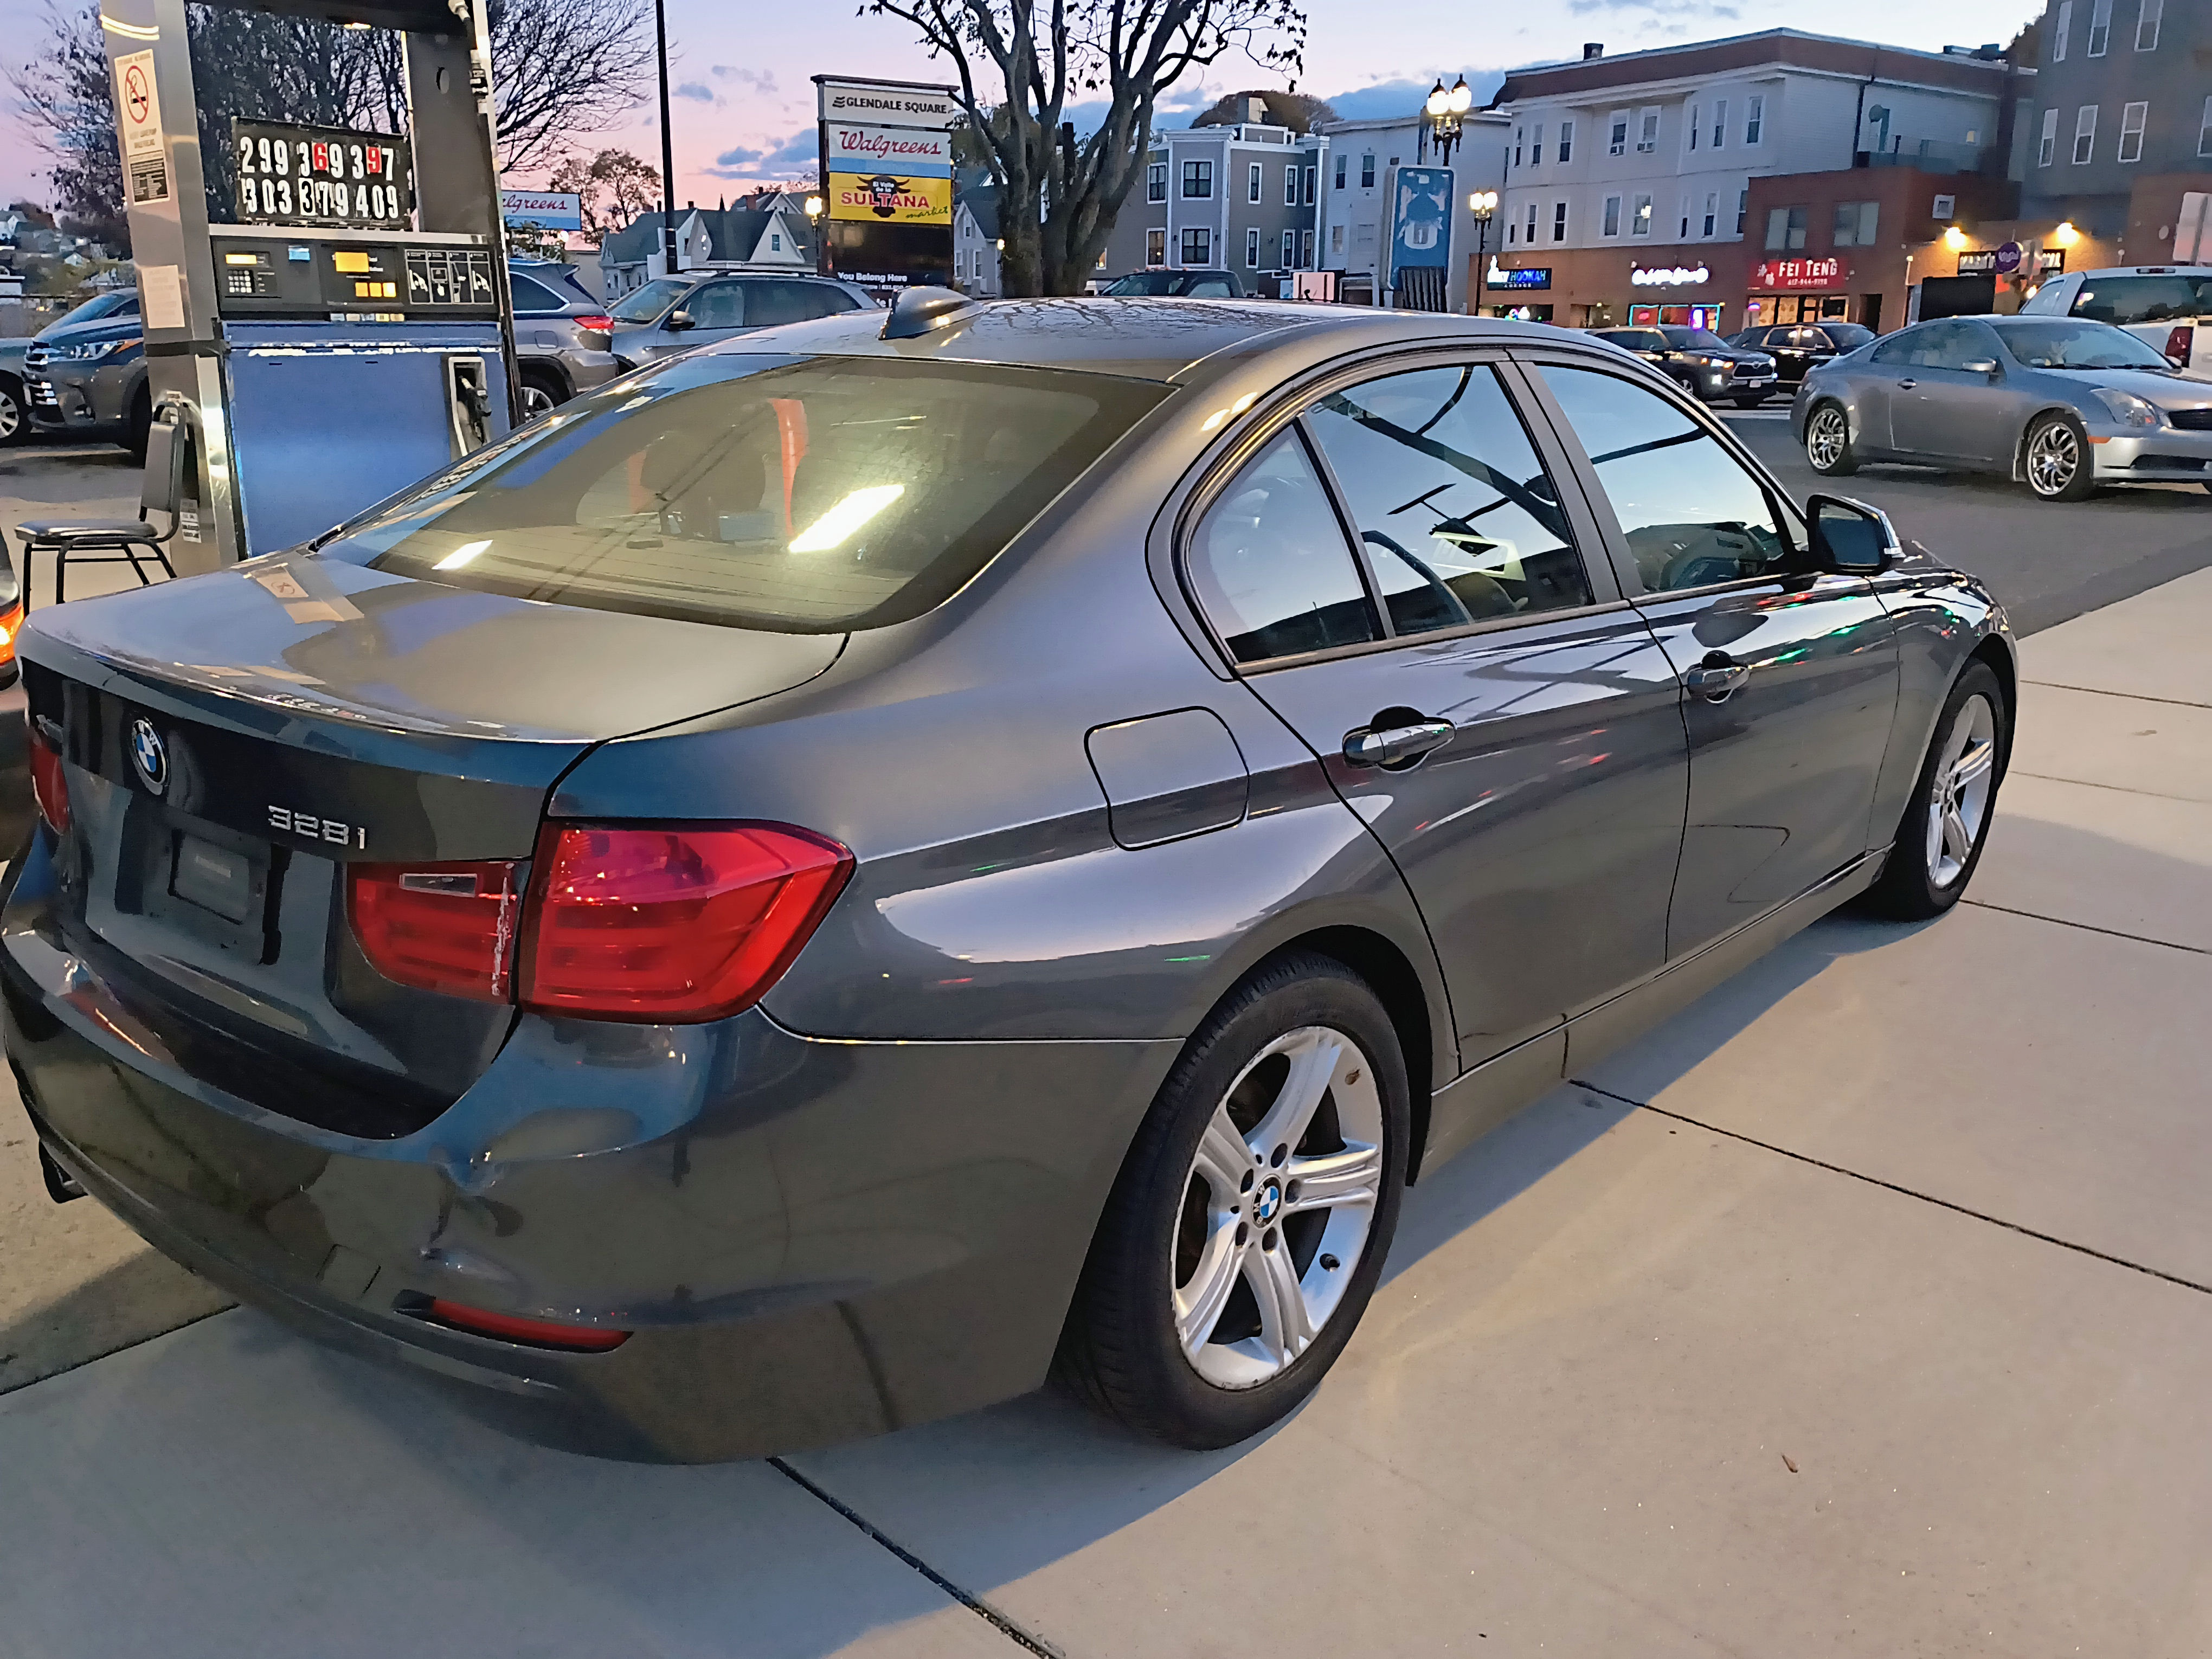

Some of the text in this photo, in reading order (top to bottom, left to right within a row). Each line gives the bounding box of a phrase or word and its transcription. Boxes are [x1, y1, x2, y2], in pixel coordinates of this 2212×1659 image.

[846, 97, 947, 114] GLENDALE SQUARE
[839, 130, 942, 158] Walgreens
[240, 136, 394, 181] 299 369 397
[299, 178, 349, 216] 379
[356, 184, 398, 218] 409
[503, 194, 568, 214] lgreens
[841, 191, 929, 208] SULTANA
[905, 205, 948, 218] market
[838, 272, 908, 283] You Belong Here
[1510, 270, 1546, 281] HOOKAH
[1779, 262, 1799, 277] FEI
[1806, 261, 1838, 276] TENG
[268, 805, 365, 849] 328i
